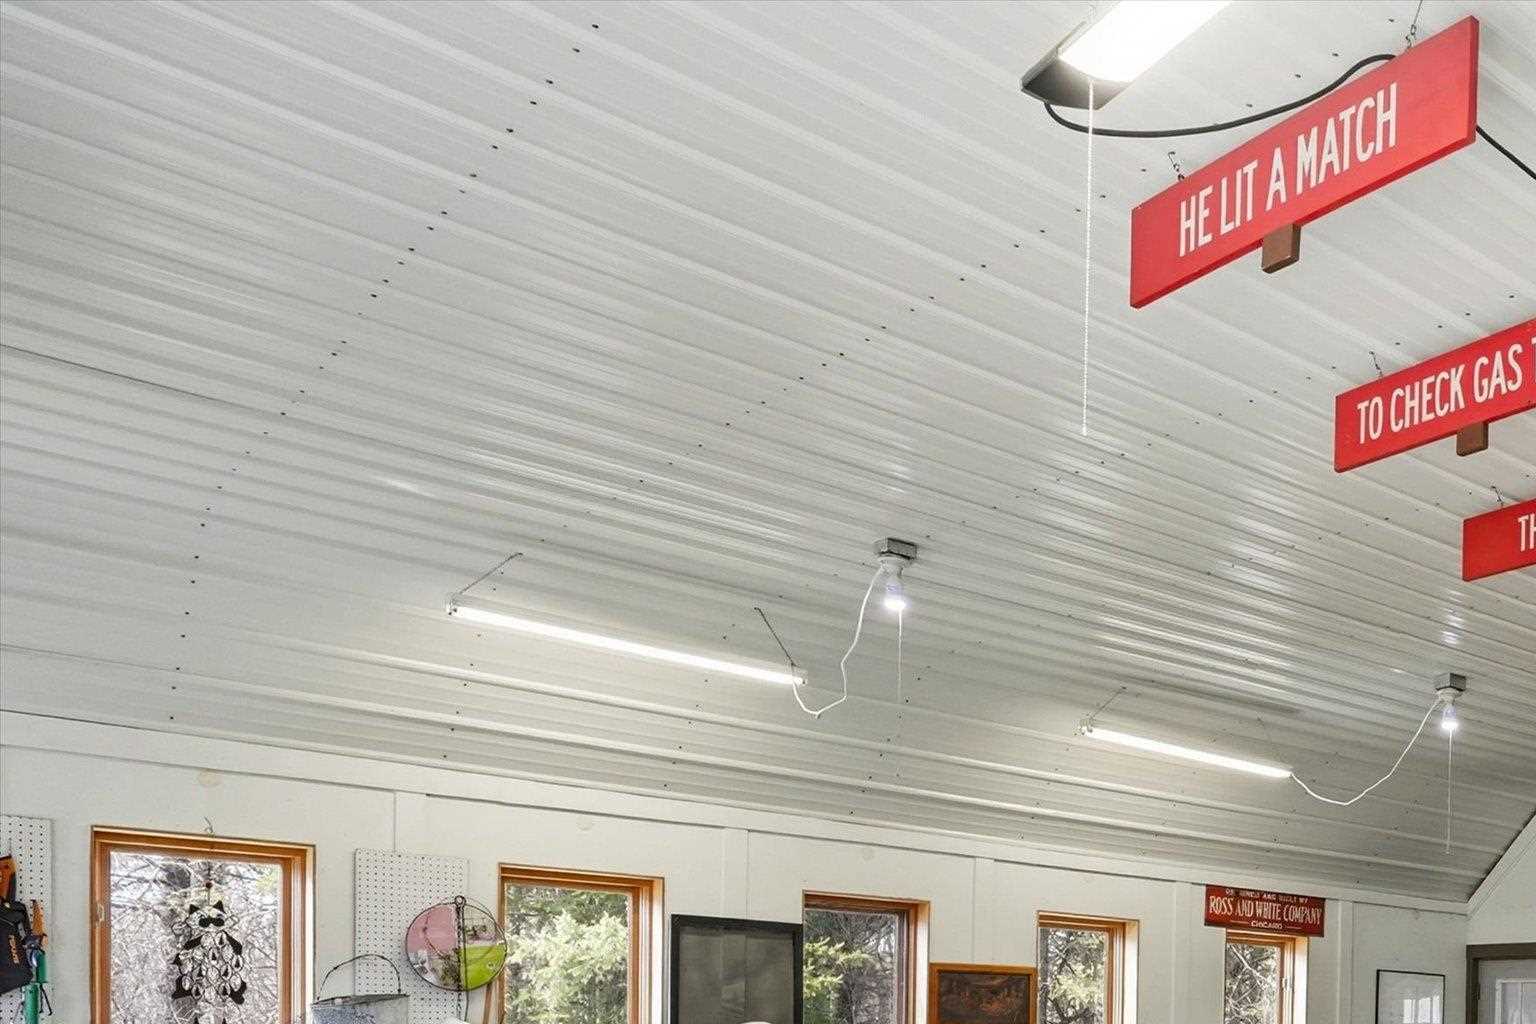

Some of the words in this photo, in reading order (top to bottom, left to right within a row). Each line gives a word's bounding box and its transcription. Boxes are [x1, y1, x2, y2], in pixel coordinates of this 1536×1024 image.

[1179, 185, 1213, 257] HE
[1220, 159, 1258, 235] LIT
[1265, 147, 1287, 211] A
[1296, 82, 1397, 196] MATCH
[1357, 396, 1383, 444] TO
[1389, 363, 1466, 432] CHECK
[1473, 344, 1523, 403] GAS
[1209, 896, 1234, 916] ROSS
[1235, 899, 1254, 918] AND
[1256, 901, 1281, 921] WHITE
[1283, 904, 1322, 925] COMPANY
